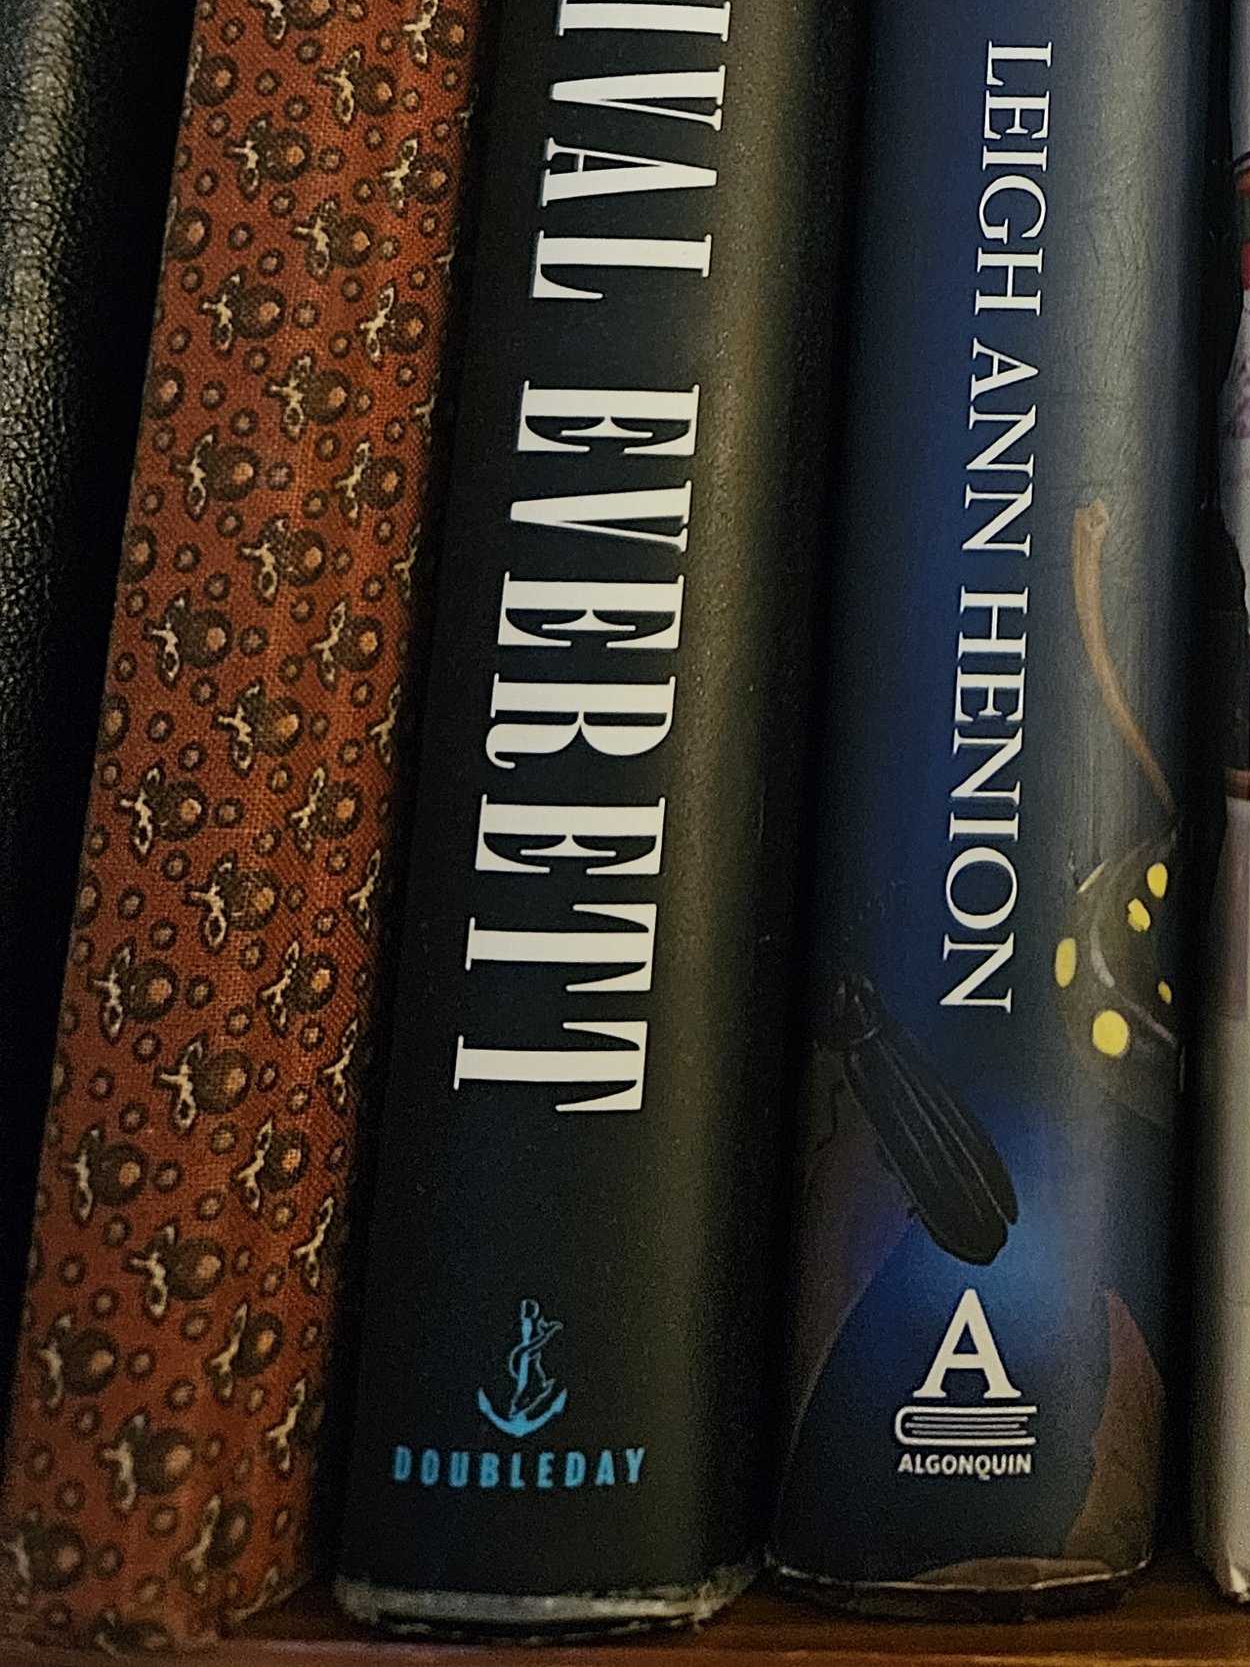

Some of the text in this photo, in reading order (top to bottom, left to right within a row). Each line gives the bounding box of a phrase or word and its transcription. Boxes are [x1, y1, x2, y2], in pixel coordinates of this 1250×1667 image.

[939, 40, 1053, 1014] LEIGH ANN HENION
[453, 380, 700, 1112] EVERETT
[912, 1288, 1023, 1399] A
[393, 1445, 646, 1489] DOUBLEDAY
[897, 1452, 1033, 1481] ALGONQUIN
